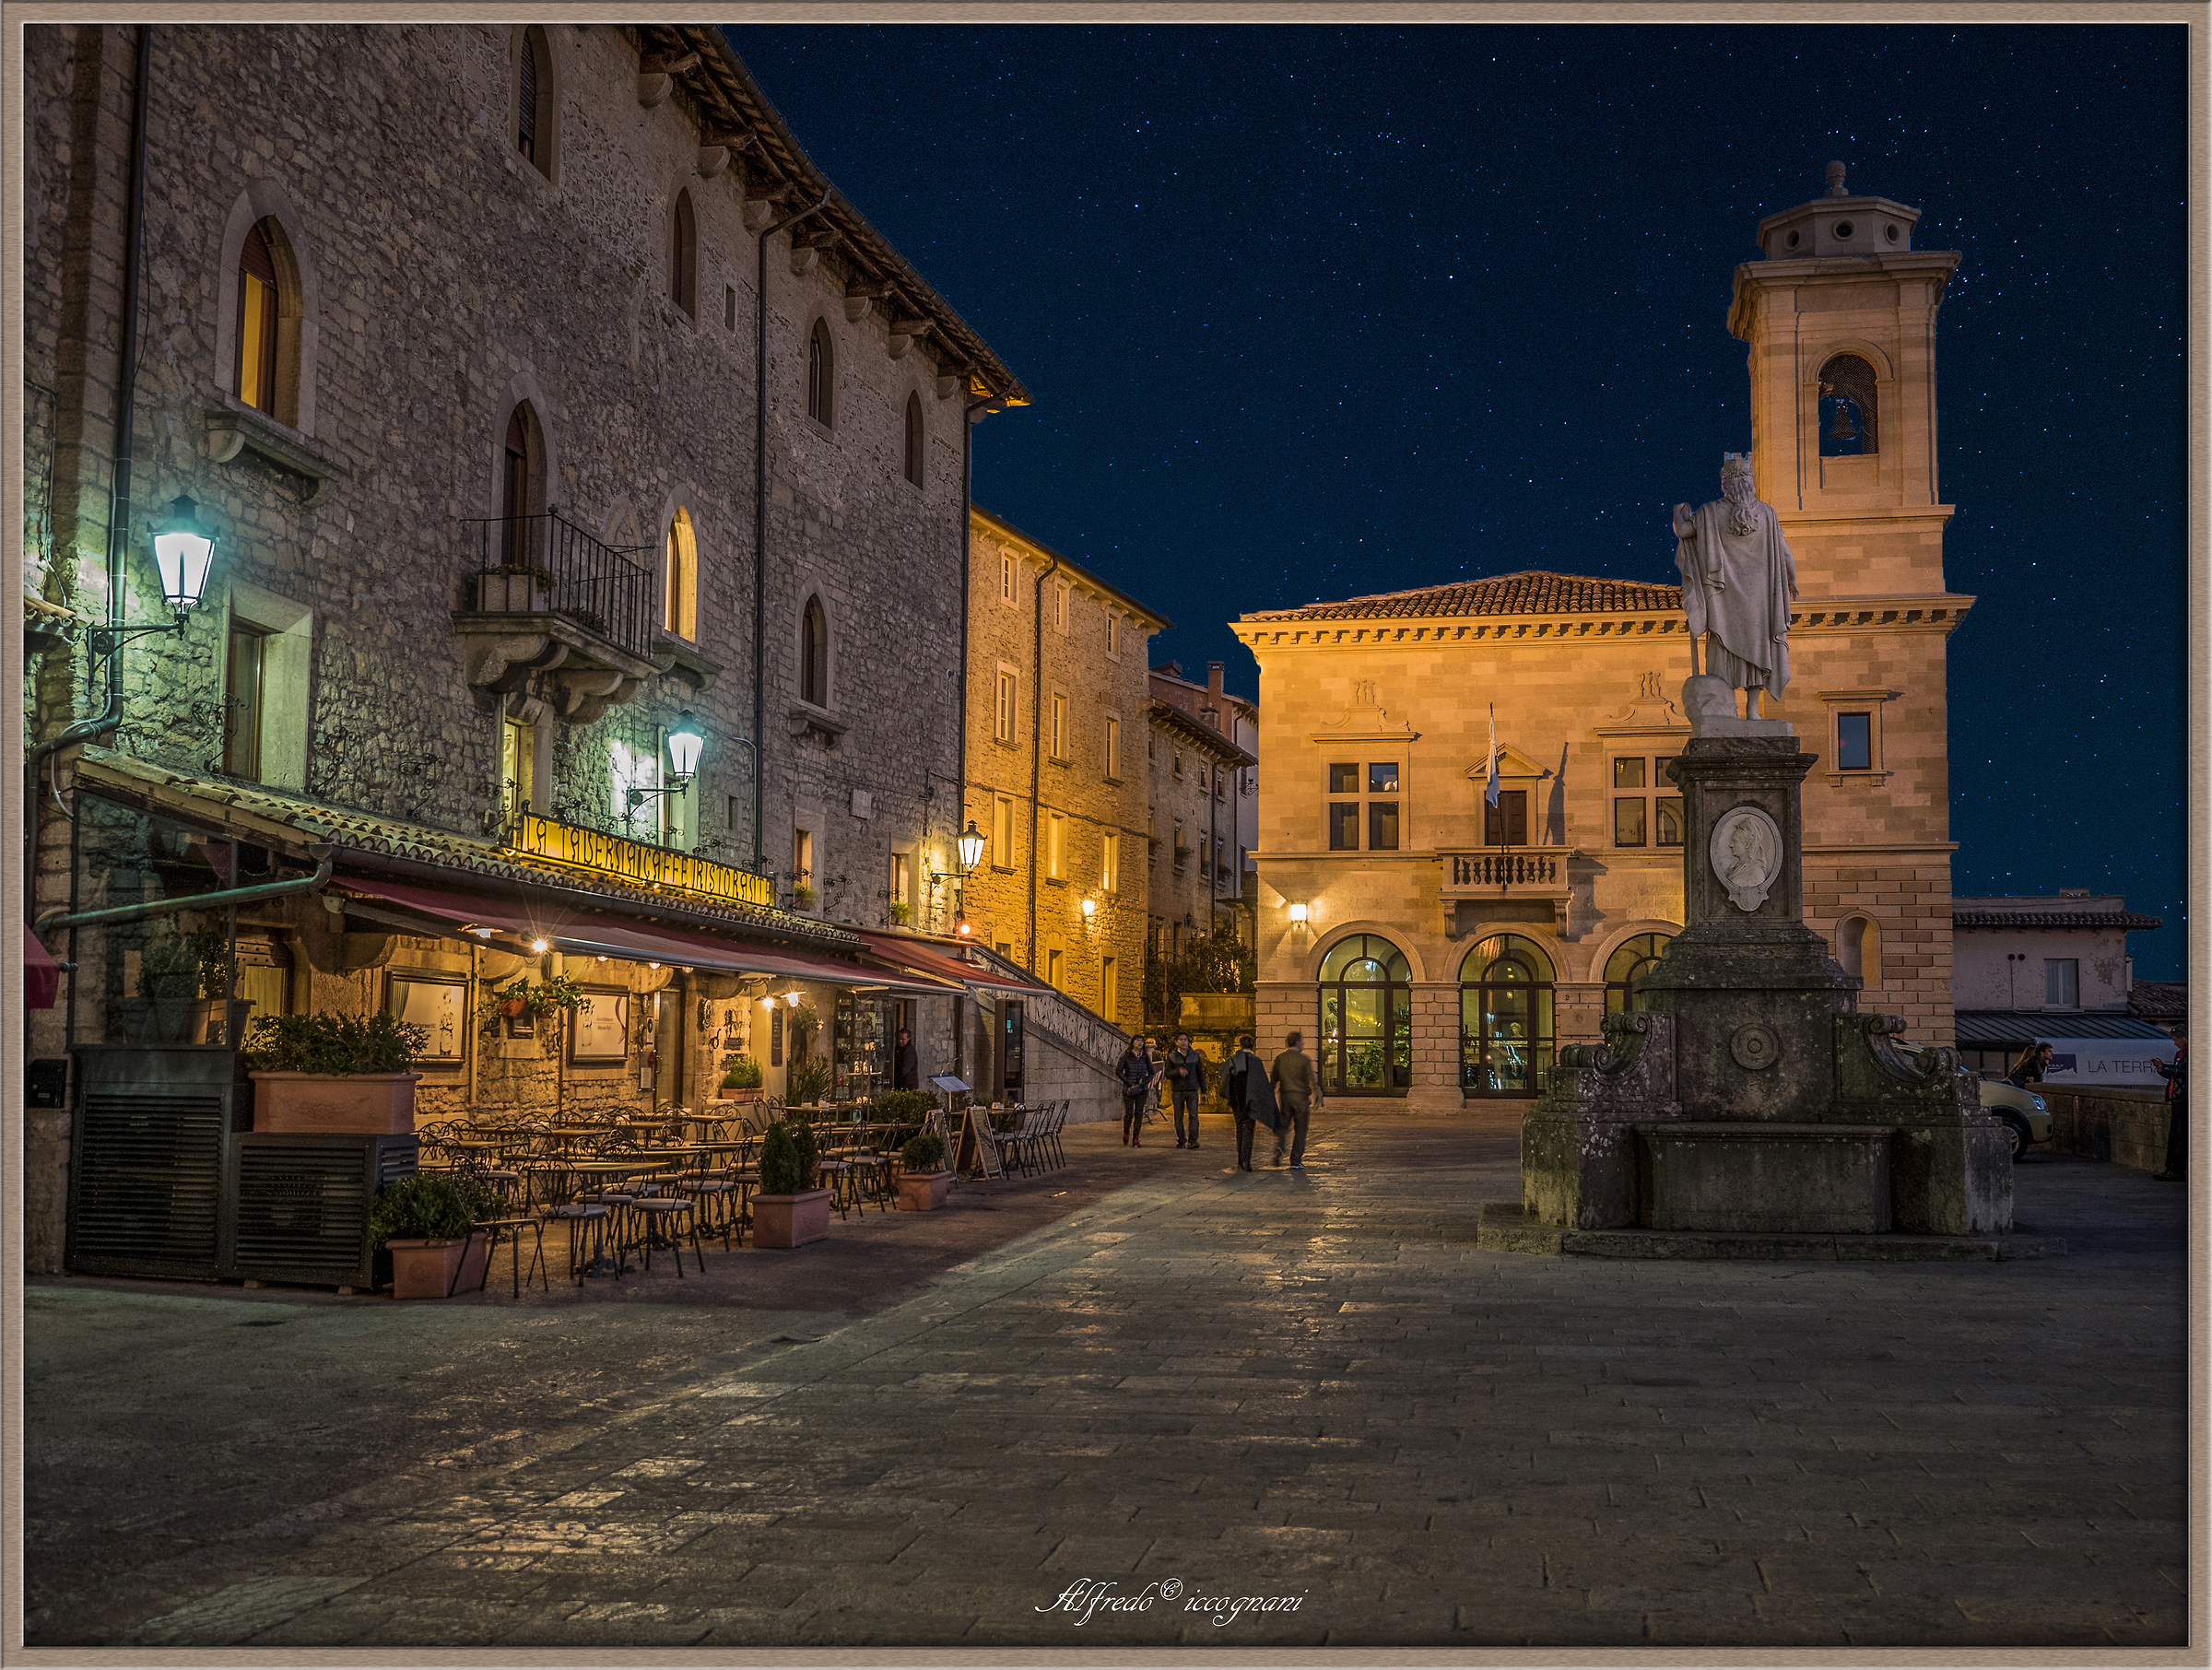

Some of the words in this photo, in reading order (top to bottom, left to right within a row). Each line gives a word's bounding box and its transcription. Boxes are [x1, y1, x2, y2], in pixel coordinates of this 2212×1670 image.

[526, 815, 547, 855] LA
[559, 823, 636, 876] TAVERNA
[696, 859, 771, 906] RISTORANTE
[2088, 1060, 2108, 1073] LA
[2112, 1060, 2173, 1074] TERR
